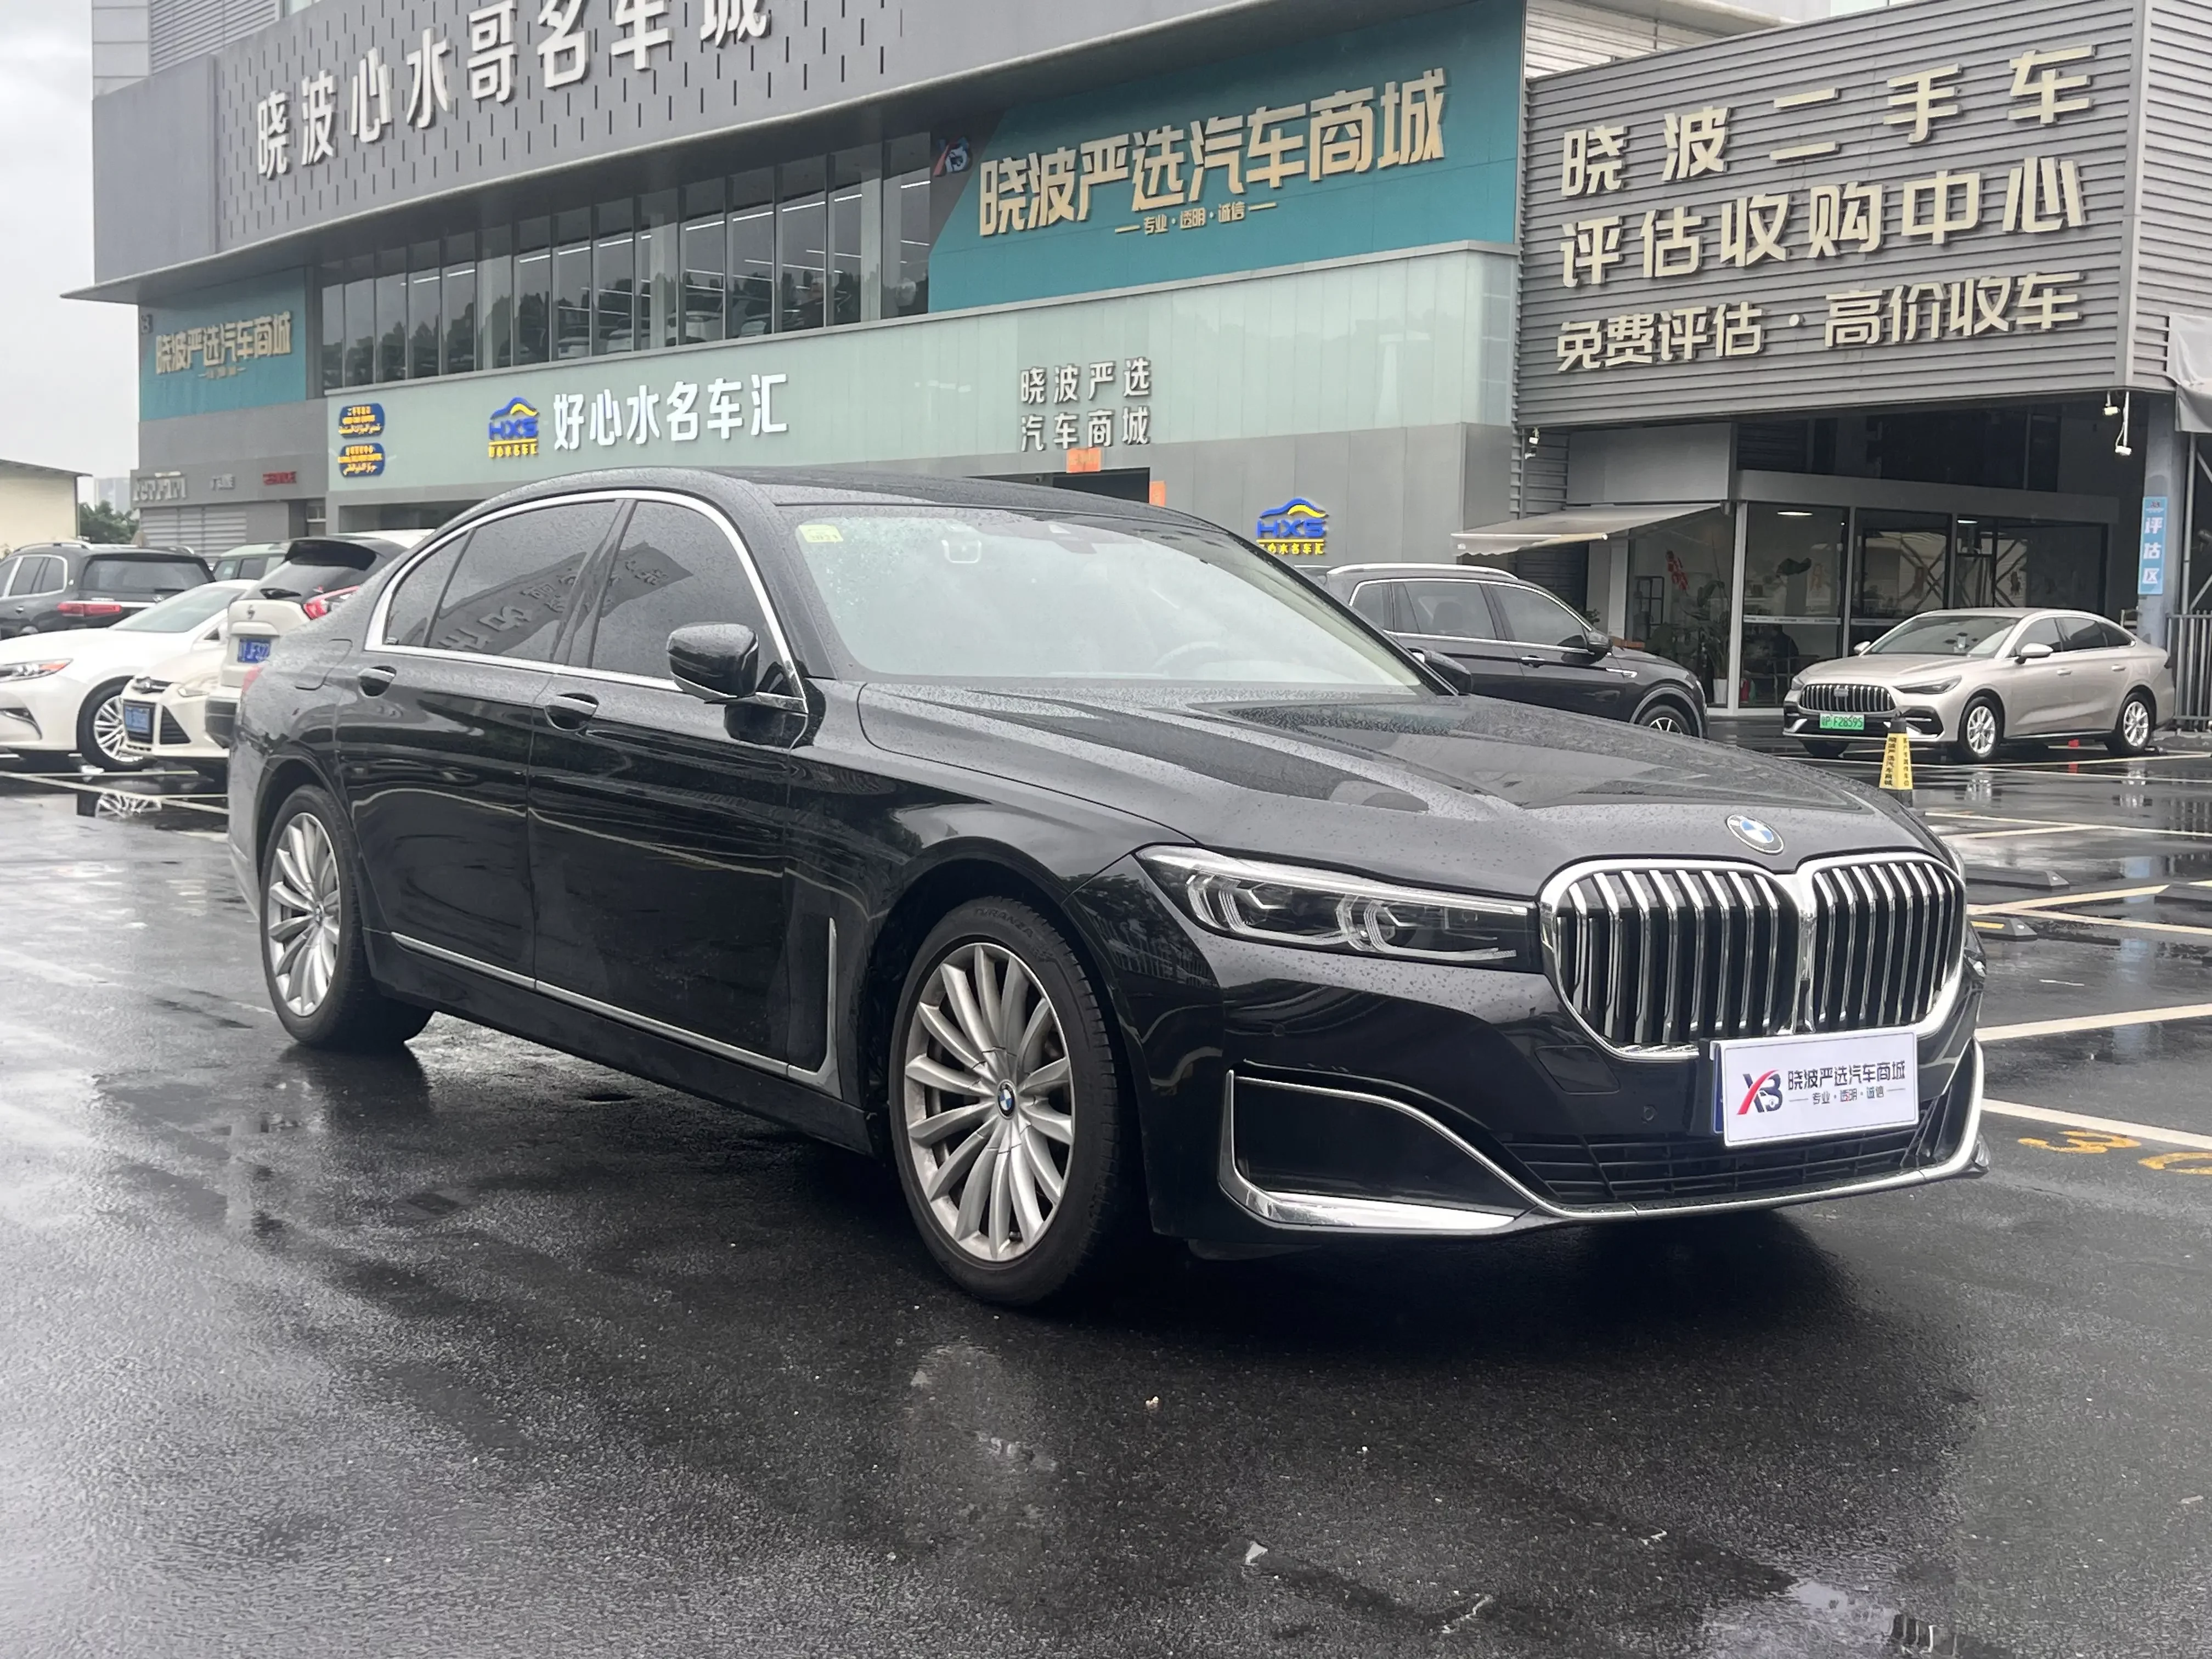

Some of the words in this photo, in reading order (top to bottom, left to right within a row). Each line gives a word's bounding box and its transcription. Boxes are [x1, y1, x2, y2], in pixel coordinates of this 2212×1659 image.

[1561, 44, 2096, 198] 晓波二手车
[979, 67, 1446, 237] 晓波严选汽车商城
[1560, 156, 2085, 288] 评估收购中心
[1020, 357, 1150, 404] 晓波严选
[488, 417, 539, 441] HXS
[554, 373, 788, 451] 好心水名车汇
[1020, 406, 1150, 452] 汽车商城
[1257, 518, 1326, 538] HXS
[1259, 542, 1325, 555] 心水名车汇
[2142, 517, 2163, 584] 评估区
[1788, 1059, 1905, 1091] 晓波严选汽车商城
